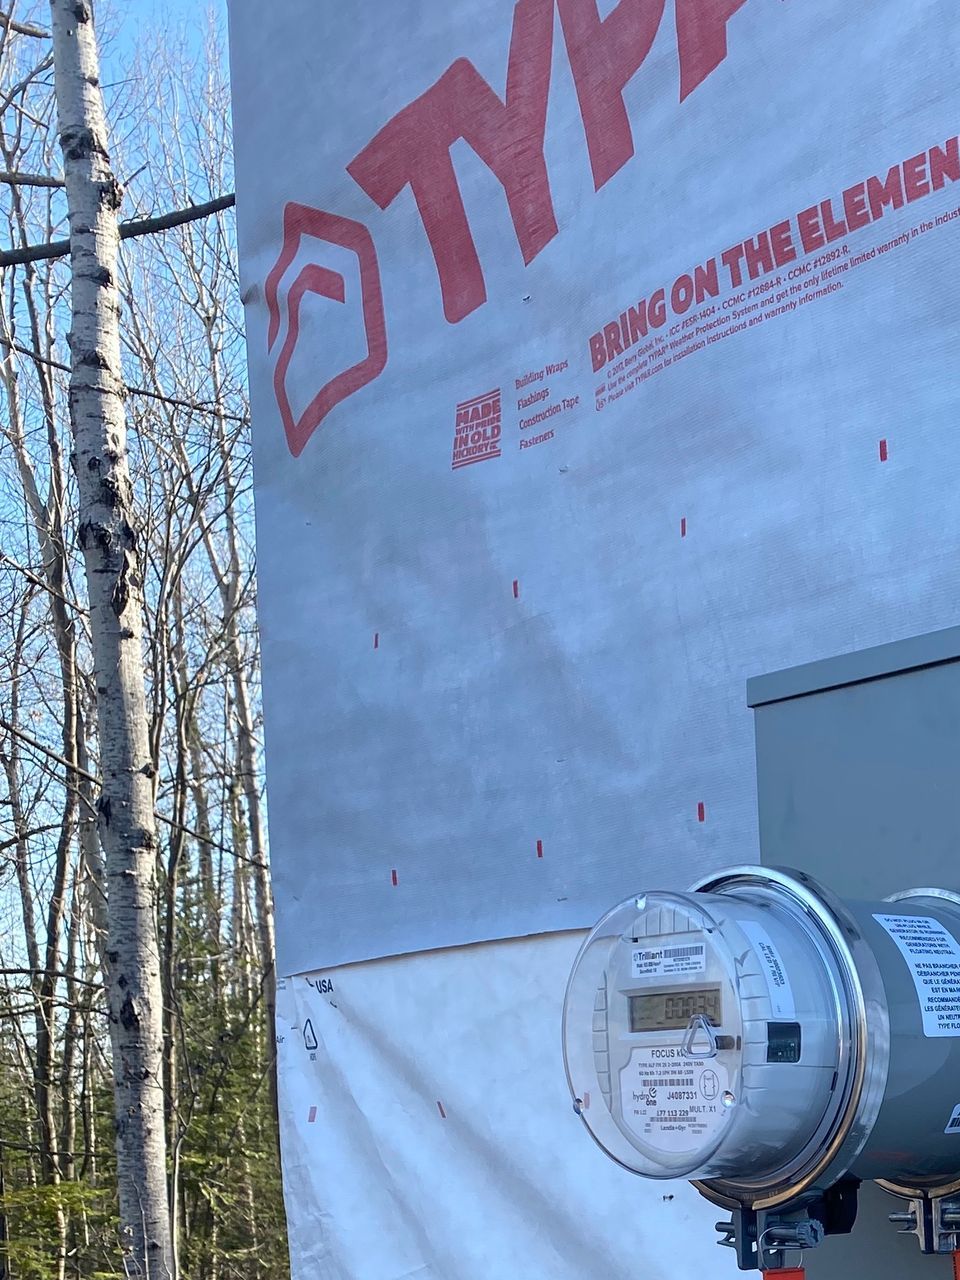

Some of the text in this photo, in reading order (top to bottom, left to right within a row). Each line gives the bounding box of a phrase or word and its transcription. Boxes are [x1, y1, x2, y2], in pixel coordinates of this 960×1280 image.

[695, 314, 730, 336] Protection
[731, 302, 758, 320] System
[759, 293, 773, 308] and
[775, 286, 788, 303] get
[789, 282, 802, 294] the
[803, 275, 819, 288] only
[820, 262, 848, 281] lifetime
[849, 248, 875, 267] limited
[876, 233, 909, 255] warranty
[910, 227, 918, 239] in
[919, 220, 932, 233] the
[589, 288, 667, 373] BRING
[671, 257, 719, 315] ON
[721, 219, 797, 288] THE
[706, 321, 746, 345] instructions
[748, 313, 762, 326] and
[764, 300, 797, 320] warranty
[798, 281, 844, 305] information.
[515, 358, 569, 390] Building Wraps
[518, 387, 550, 410] Flashings
[456, 397, 501, 427] MADE
[519, 402, 561, 430] Construction
[561, 394, 580, 412] Tape
[454, 433, 469, 450] IN
[470, 424, 501, 444] OLD
[456, 414, 501, 436] WITH PRIDE
[519, 429, 555, 450] Fasteners
[638, 950, 663, 961] Trilliant
[315, 979, 334, 994] USA
[652, 1049, 675, 1058] FOCUS
[633, 1091, 650, 1102] hydro
